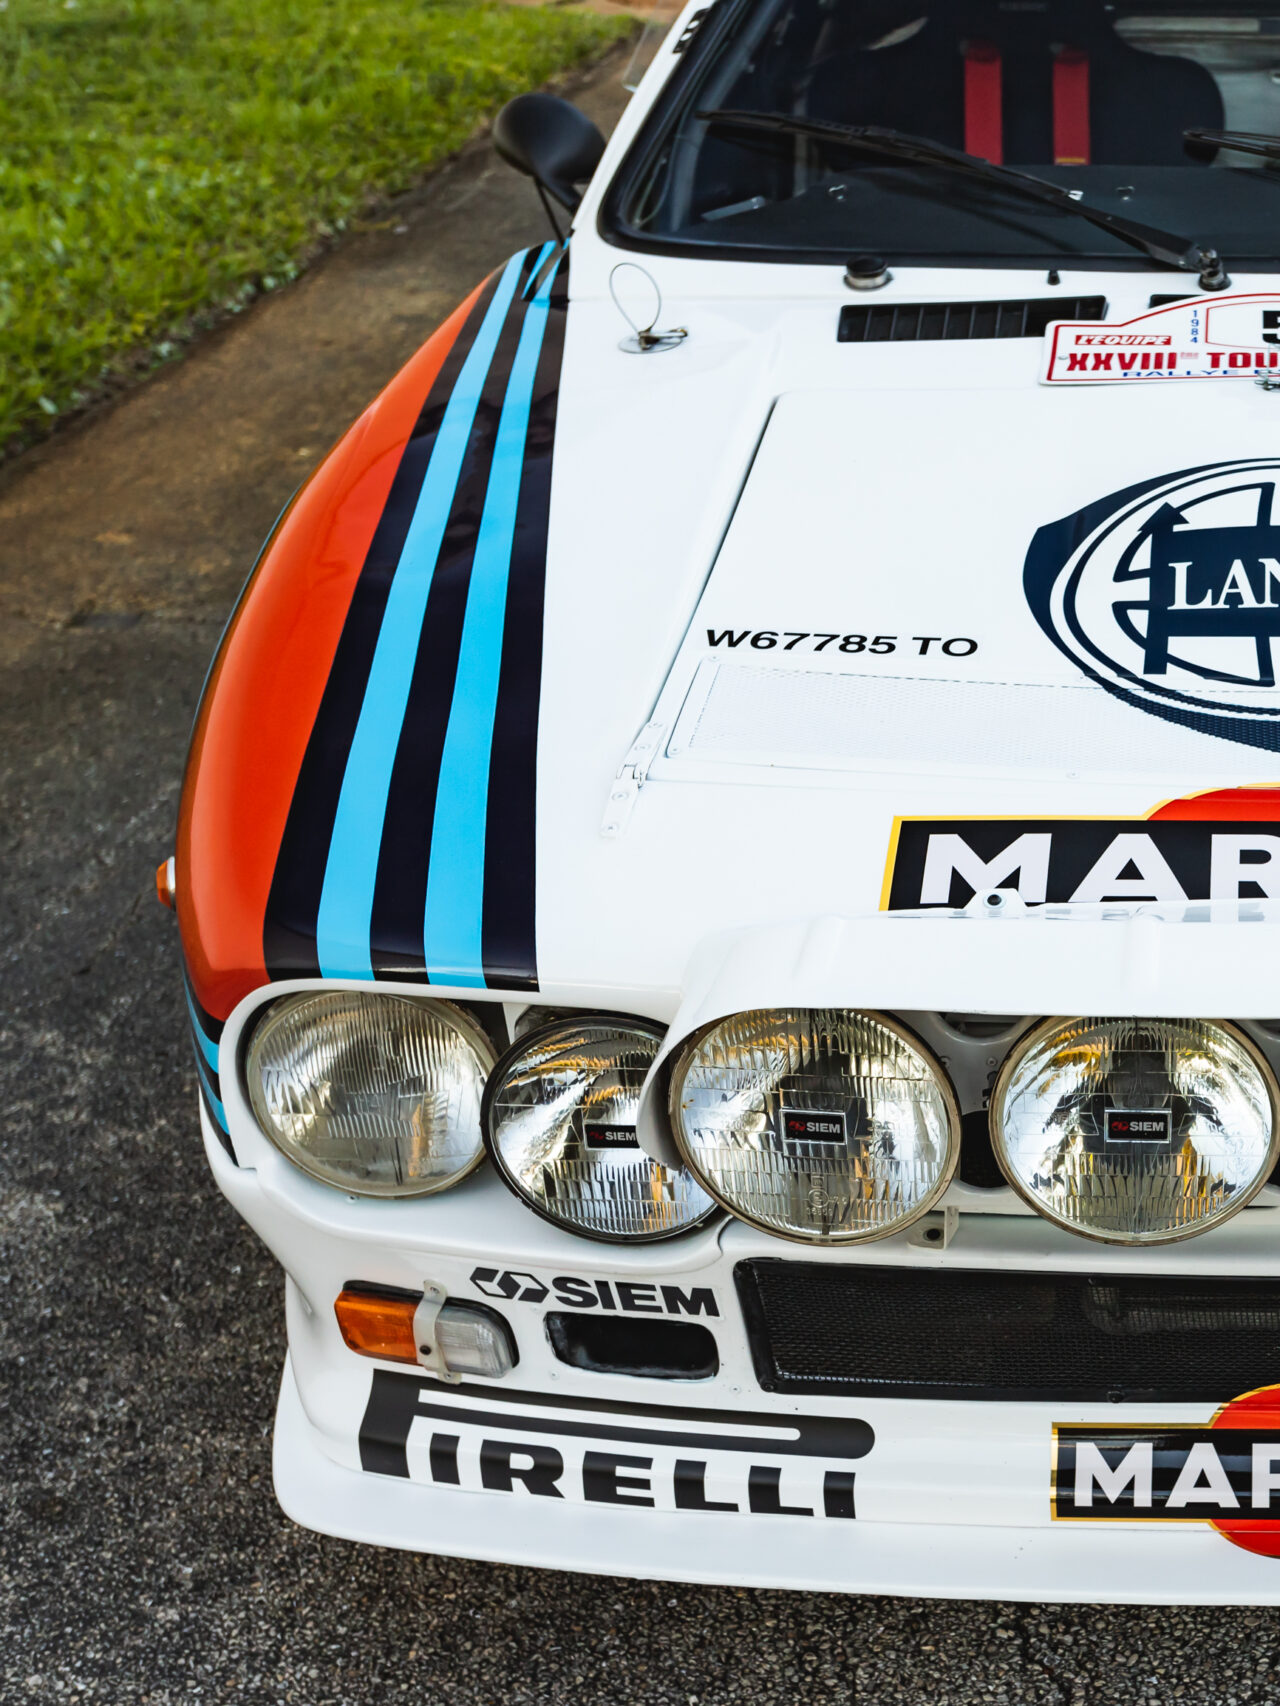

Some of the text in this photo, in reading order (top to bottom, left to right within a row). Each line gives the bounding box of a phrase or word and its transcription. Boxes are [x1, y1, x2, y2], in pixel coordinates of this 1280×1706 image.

[1190, 310, 1199, 343] 1984
[1123, 370, 1238, 378] RALLYE
[706, 629, 979, 657] W67785 TO
[605, 1131, 636, 1141] SIEM
[806, 1122, 841, 1133] SIEM
[1129, 1121, 1164, 1132] SIEM
[547, 1275, 721, 1317] SIEM
[358, 1368, 876, 1519] PIRELLI
